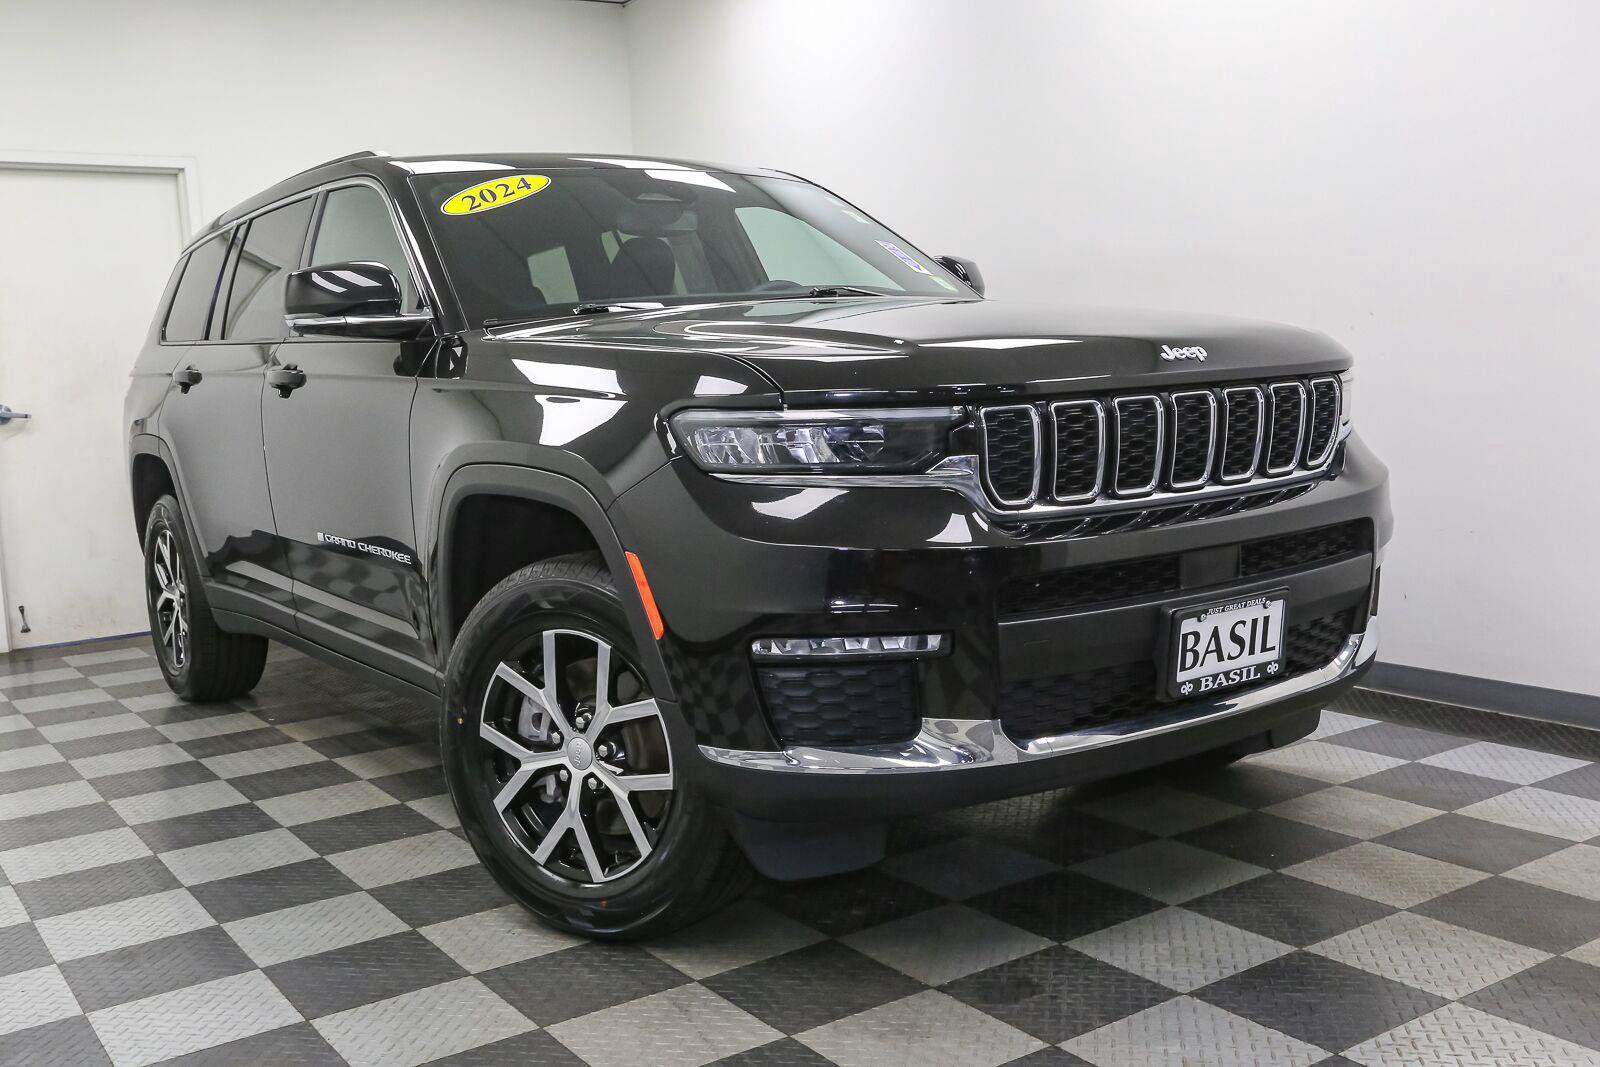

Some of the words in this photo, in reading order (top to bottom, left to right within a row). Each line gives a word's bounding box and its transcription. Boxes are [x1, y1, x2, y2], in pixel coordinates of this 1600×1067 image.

[461, 177, 532, 210] 2024
[1160, 344, 1208, 361] Jeep
[324, 534, 356, 549] GRAND
[357, 542, 412, 565] CHEROKEE
[1207, 607, 1224, 615] JUST
[1224, 602, 1246, 612] GREAT
[1246, 597, 1266, 607] DEALS
[1179, 615, 1276, 672] BASIL
[1199, 665, 1261, 692] BASIL
